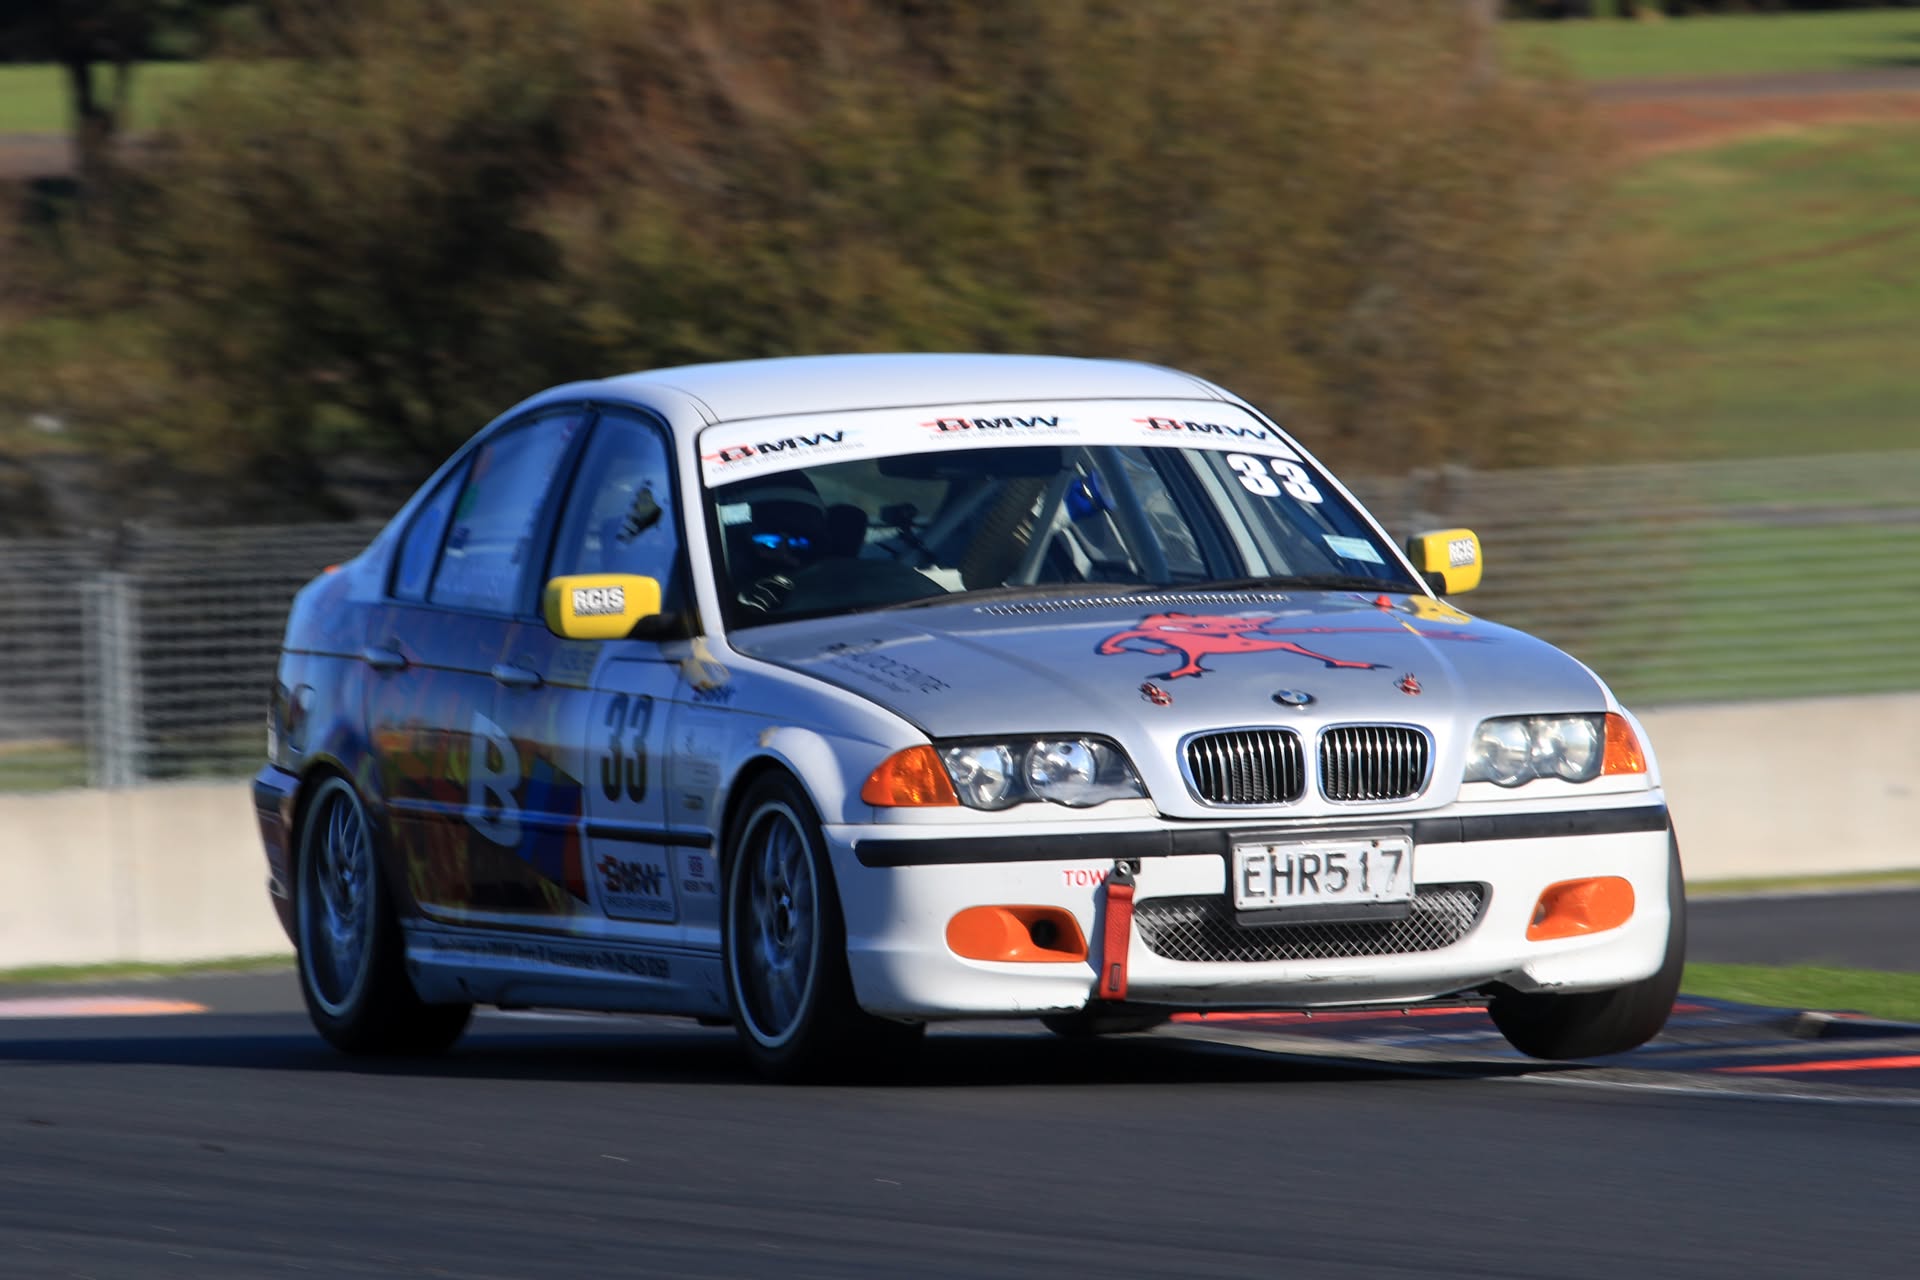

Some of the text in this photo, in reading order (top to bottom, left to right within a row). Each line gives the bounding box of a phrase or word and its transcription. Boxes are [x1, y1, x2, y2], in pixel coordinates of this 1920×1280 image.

[936, 416, 1059, 432] BMW
[1147, 416, 1267, 440] BMW
[718, 430, 844, 463] BMW
[1226, 453, 1323, 503] 33
[601, 692, 654, 803] 33
[464, 710, 522, 847] B
[1063, 868, 1110, 887] TOW
[1243, 850, 1404, 898] EHR517
